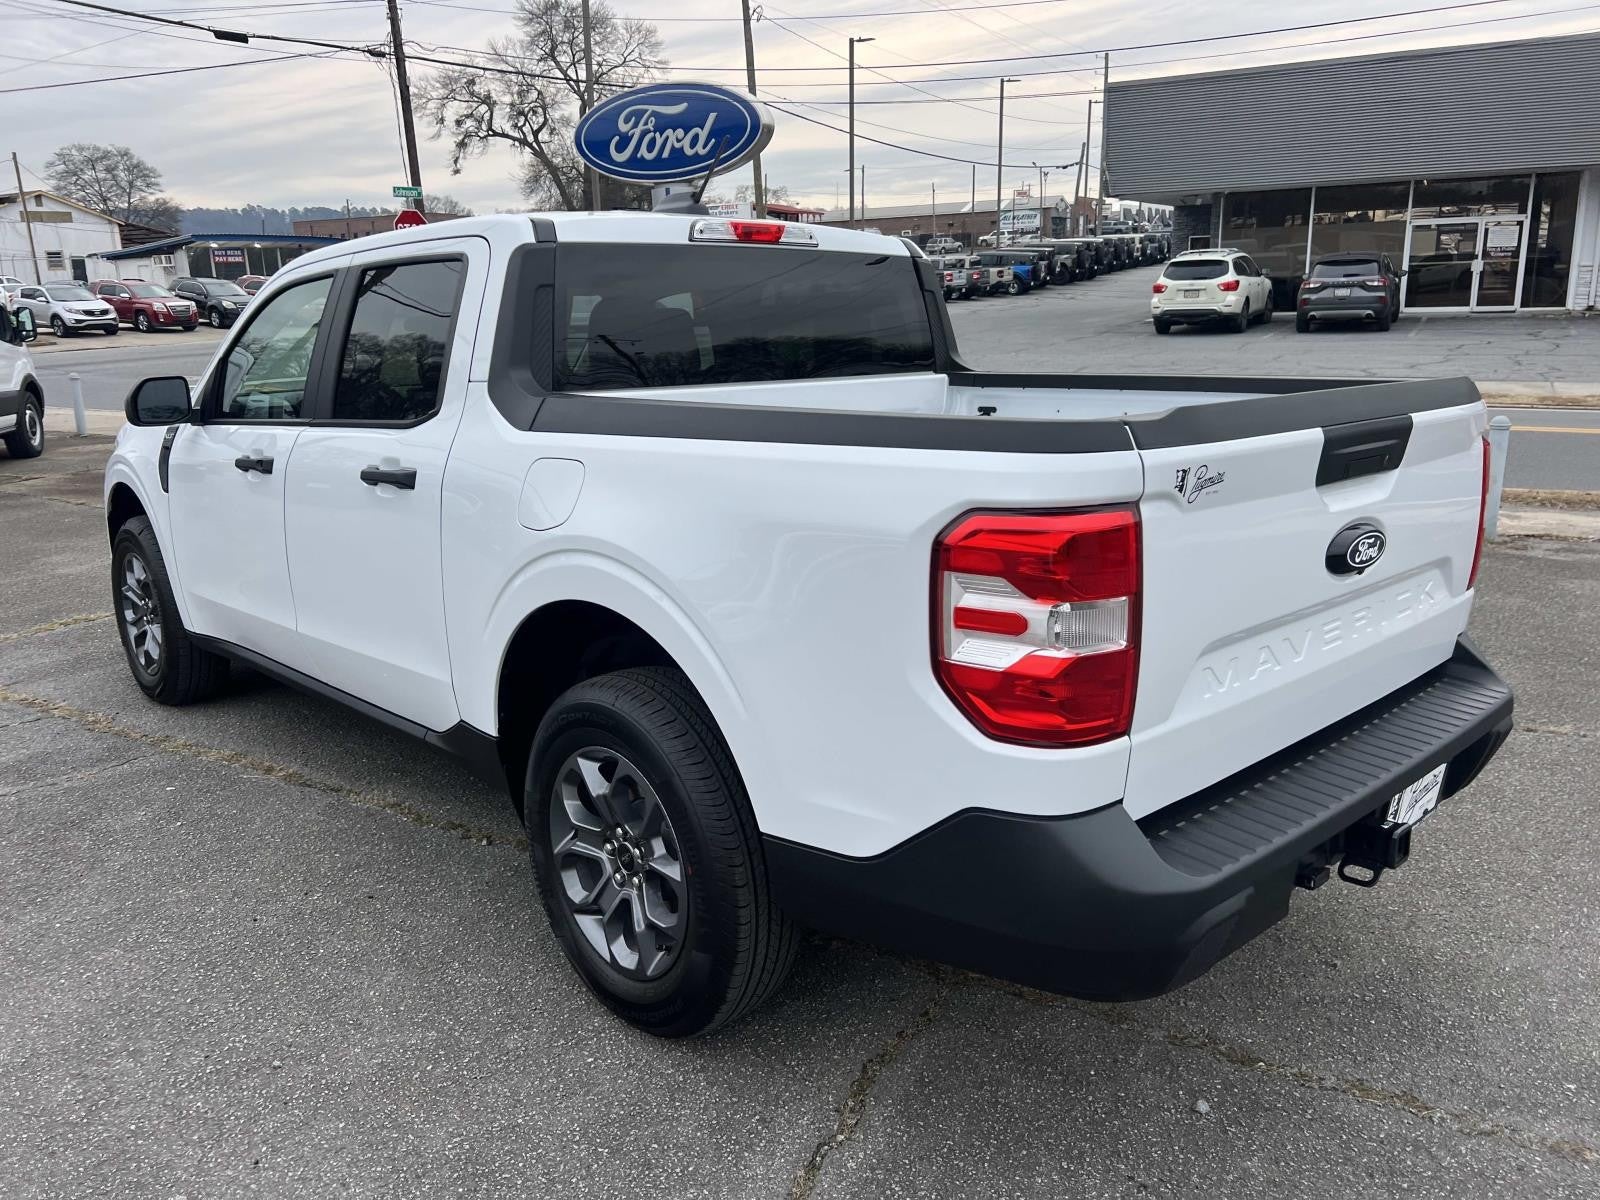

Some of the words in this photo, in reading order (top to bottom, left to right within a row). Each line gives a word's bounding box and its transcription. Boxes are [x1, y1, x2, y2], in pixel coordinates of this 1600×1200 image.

[610, 102, 718, 163] Ford
[1354, 537, 1380, 563] Ford
[1202, 580, 1436, 698] MAVERICK
